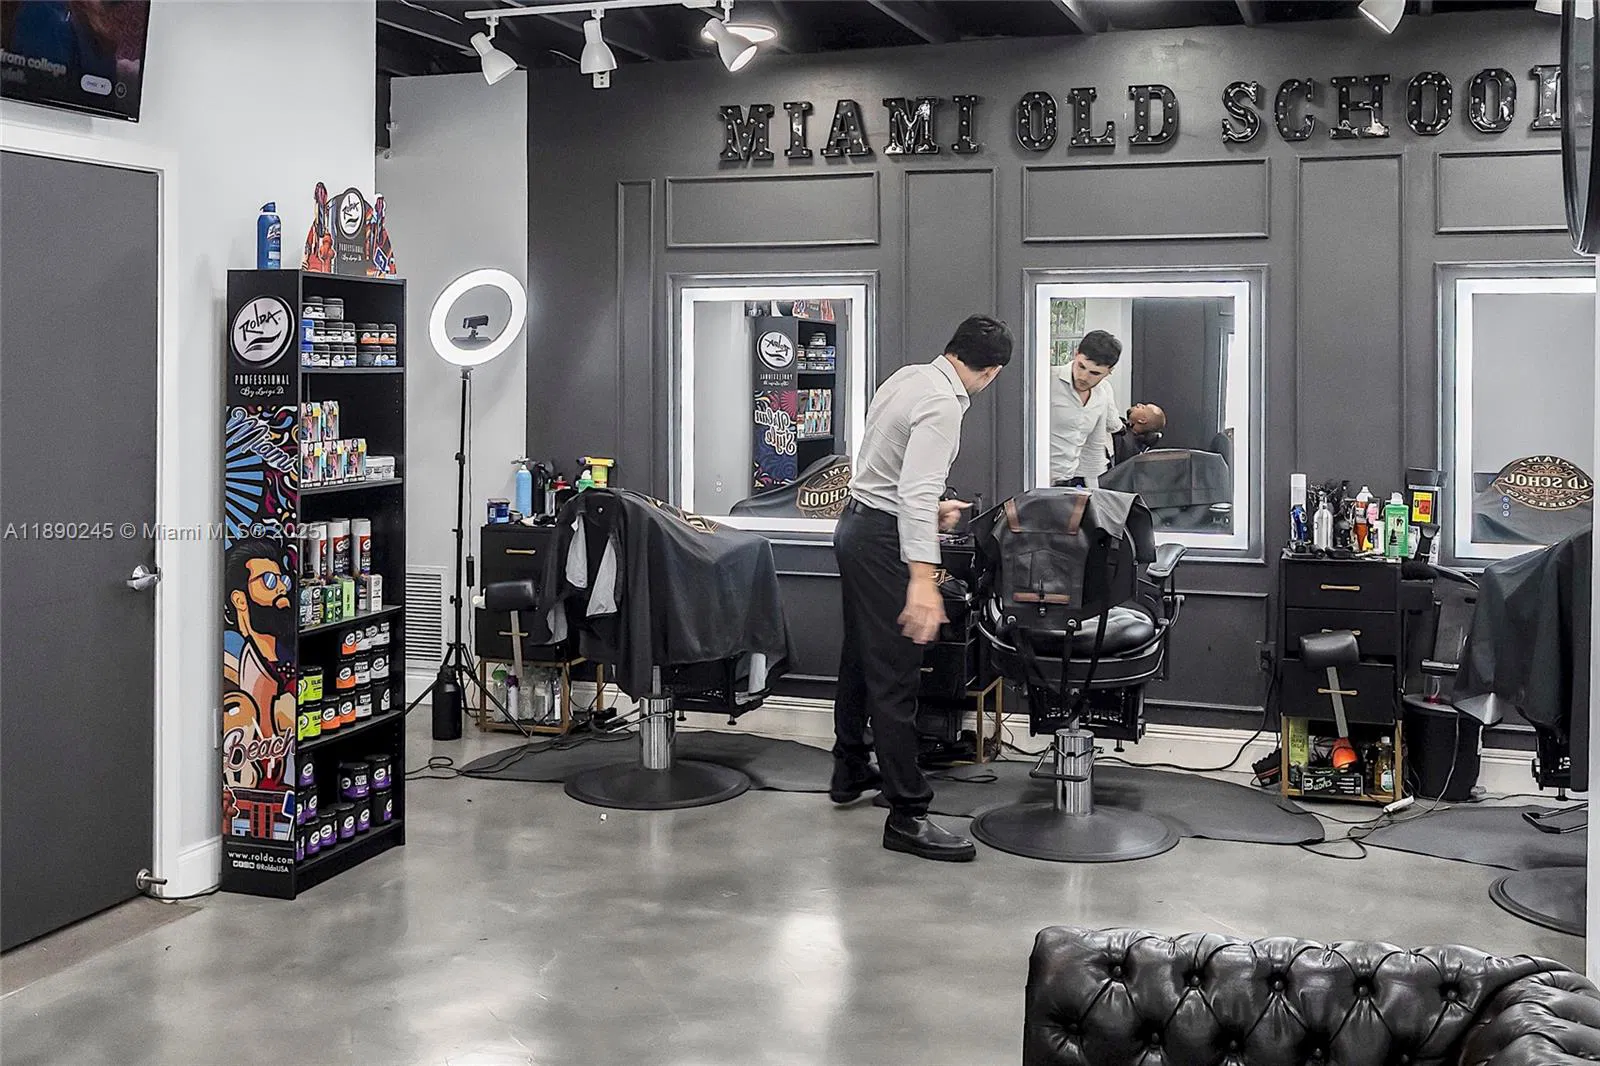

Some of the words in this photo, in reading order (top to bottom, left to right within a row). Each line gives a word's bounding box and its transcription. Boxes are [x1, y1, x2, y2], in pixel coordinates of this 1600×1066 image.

[27, 58, 67, 77] college
[718, 97, 980, 162] MIAMI
[1015, 85, 1180, 153] OLD
[234, 374, 290, 385] PROFESSIONAL
[226, 407, 299, 474] Miami
[223, 729, 296, 769] Beach
